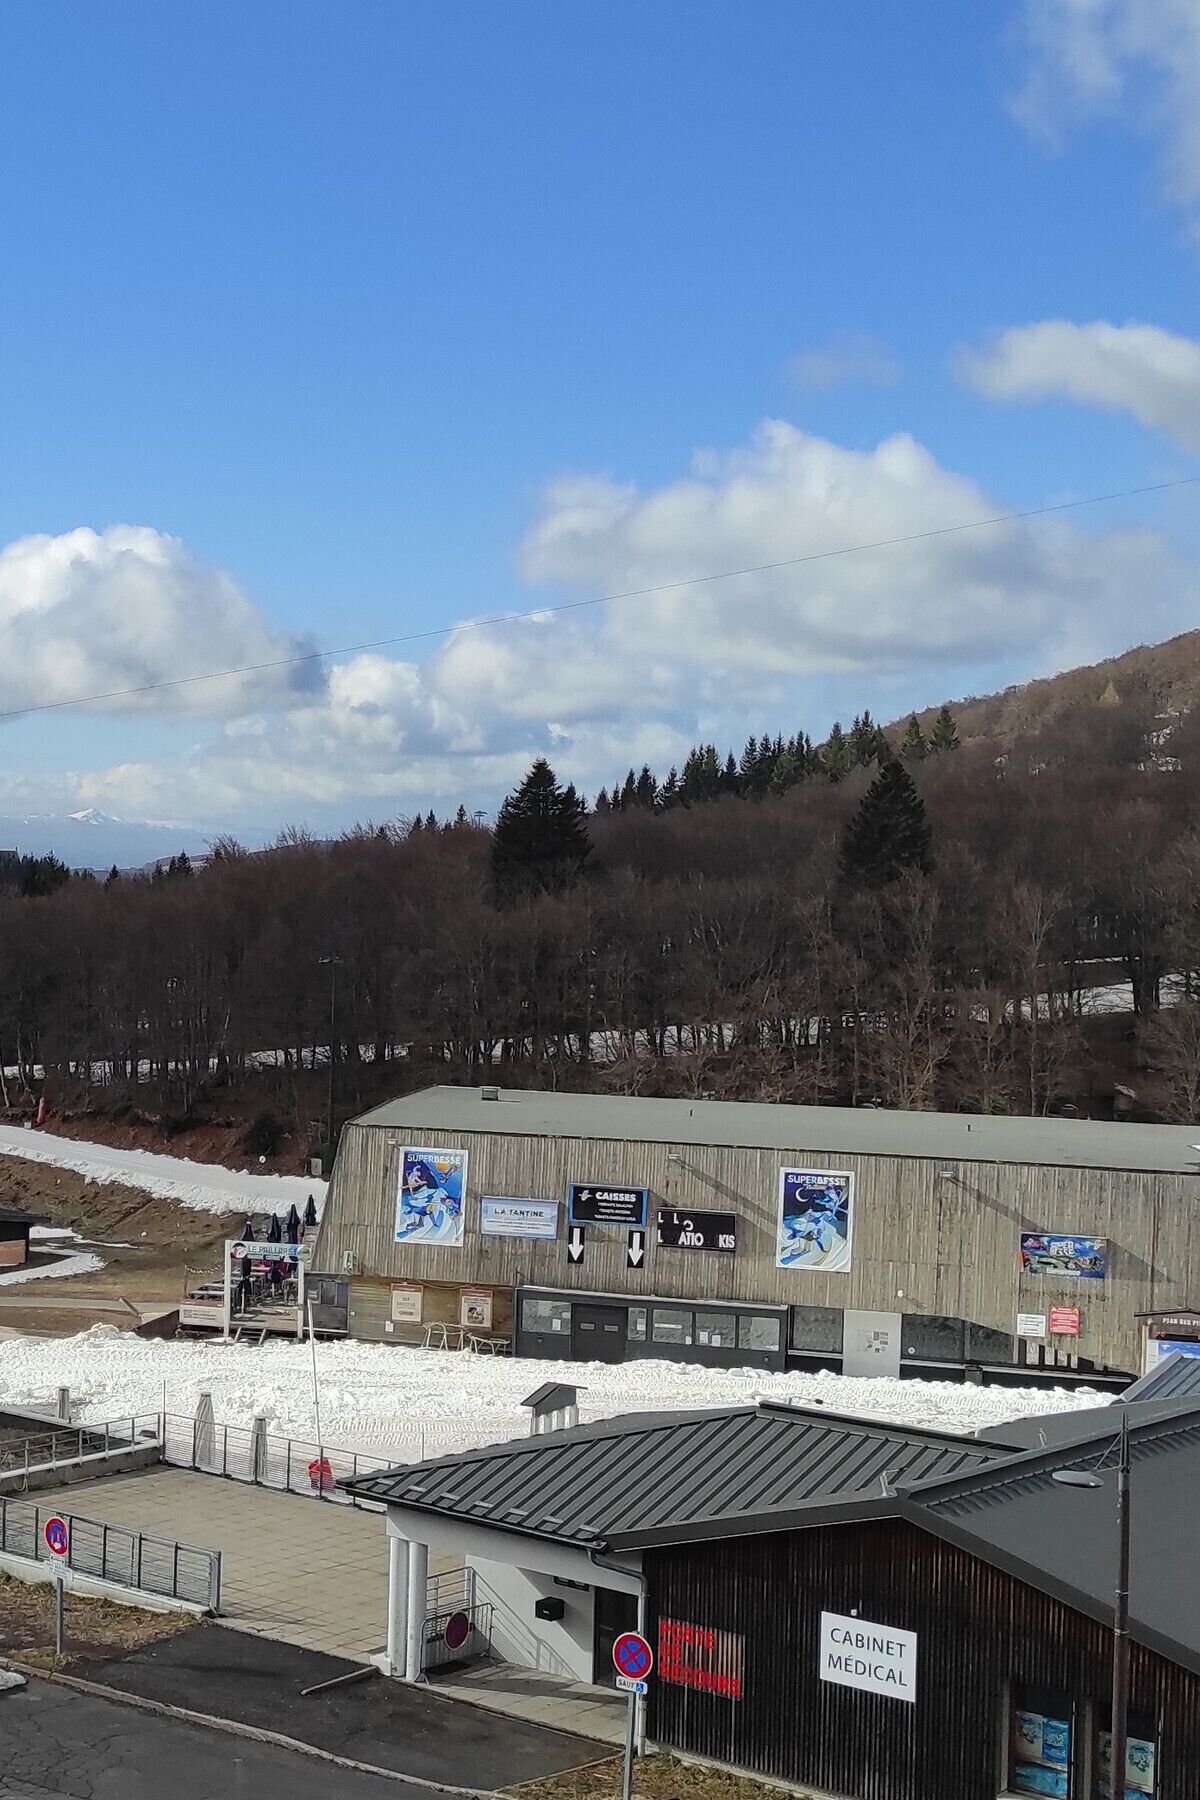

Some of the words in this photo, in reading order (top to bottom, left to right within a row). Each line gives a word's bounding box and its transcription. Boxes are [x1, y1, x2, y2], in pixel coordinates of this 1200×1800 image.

[407, 1154, 461, 1164] SUPERBESSE
[787, 1174, 847, 1186] SUPERBESSE
[595, 1191, 637, 1203] CAISSES
[508, 1208, 545, 1218] TANTINE
[660, 1620, 715, 1649] POSTE
[830, 1627, 907, 1659] CABINET
[660, 1639, 681, 1661] DE
[660, 1661, 741, 1697] SECOURS
[827, 1653, 908, 1687] MÉDICAL
